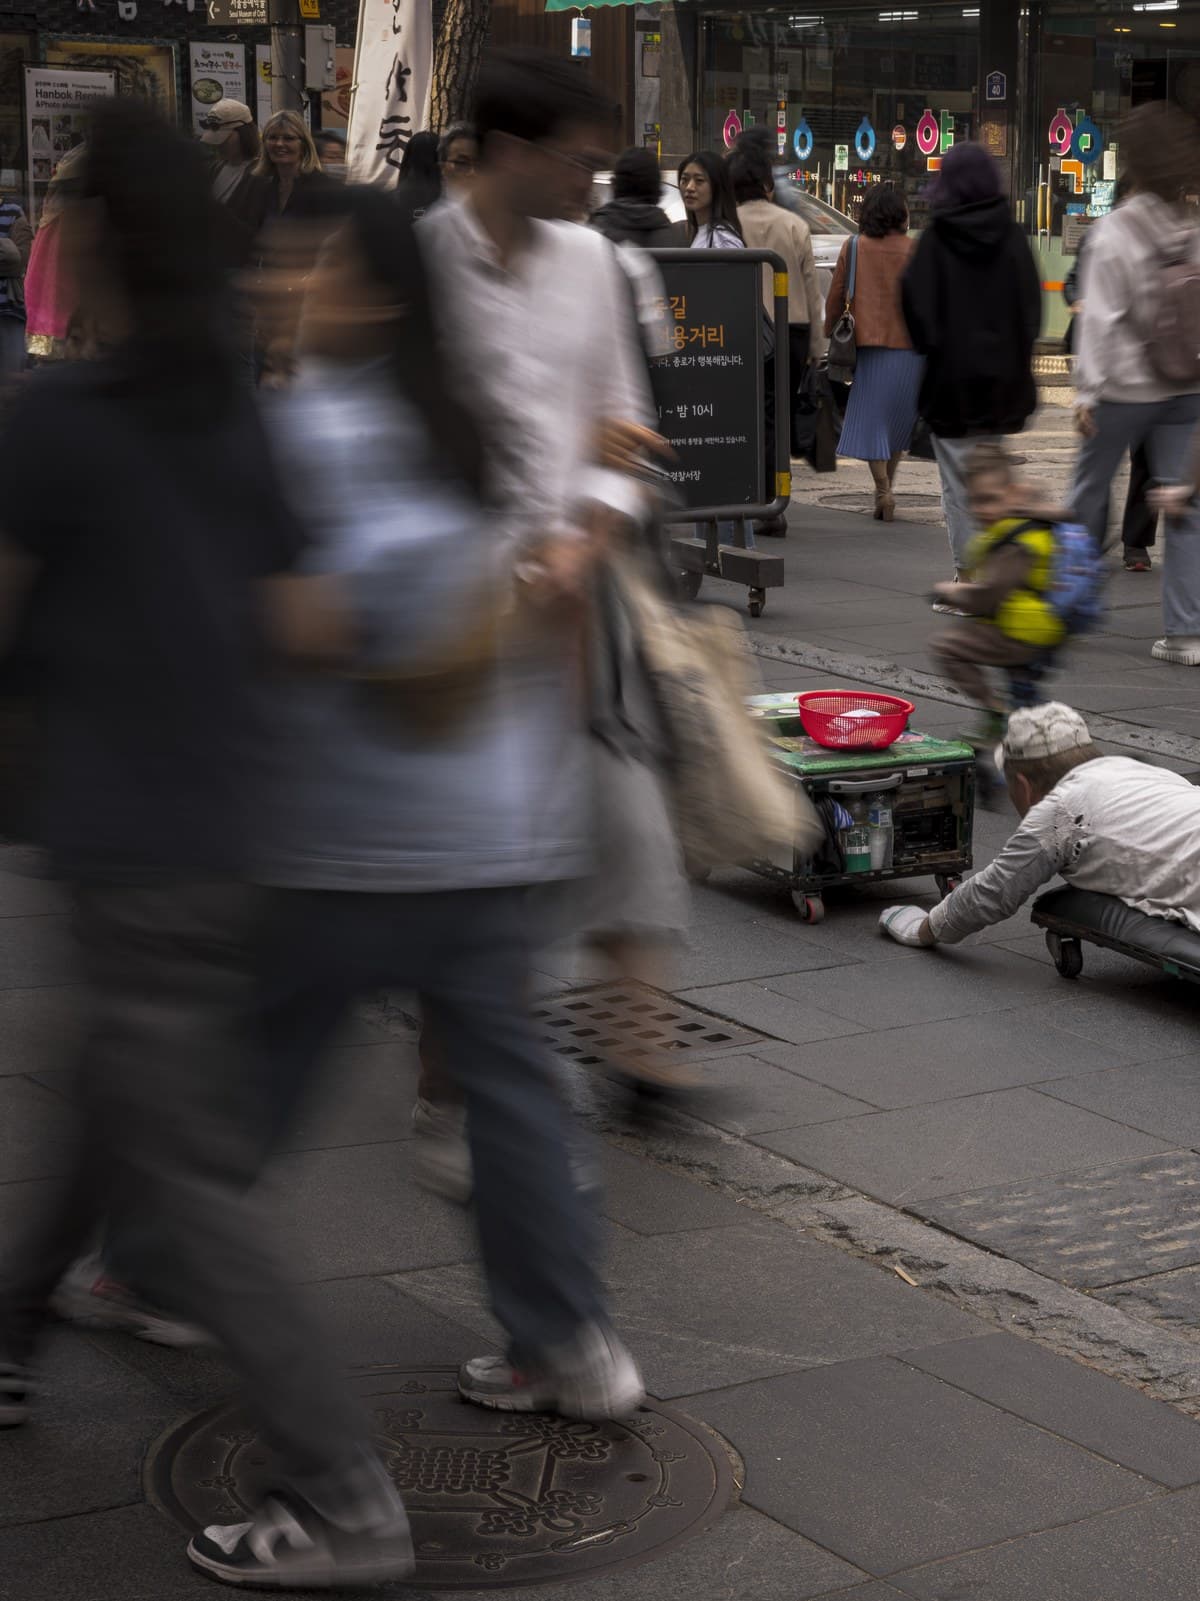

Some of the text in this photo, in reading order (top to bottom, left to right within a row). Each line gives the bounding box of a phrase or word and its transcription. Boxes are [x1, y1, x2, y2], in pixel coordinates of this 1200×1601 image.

[35, 88, 73, 100] Hanbok
[991, 85, 1001, 96] 40
[664, 324, 725, 351] 용거리
[672, 356, 696, 368] 종로가
[697, 354, 744, 367] 행복해집니다.
[676, 404, 689, 418] 밤
[692, 403, 714, 417] 10시
